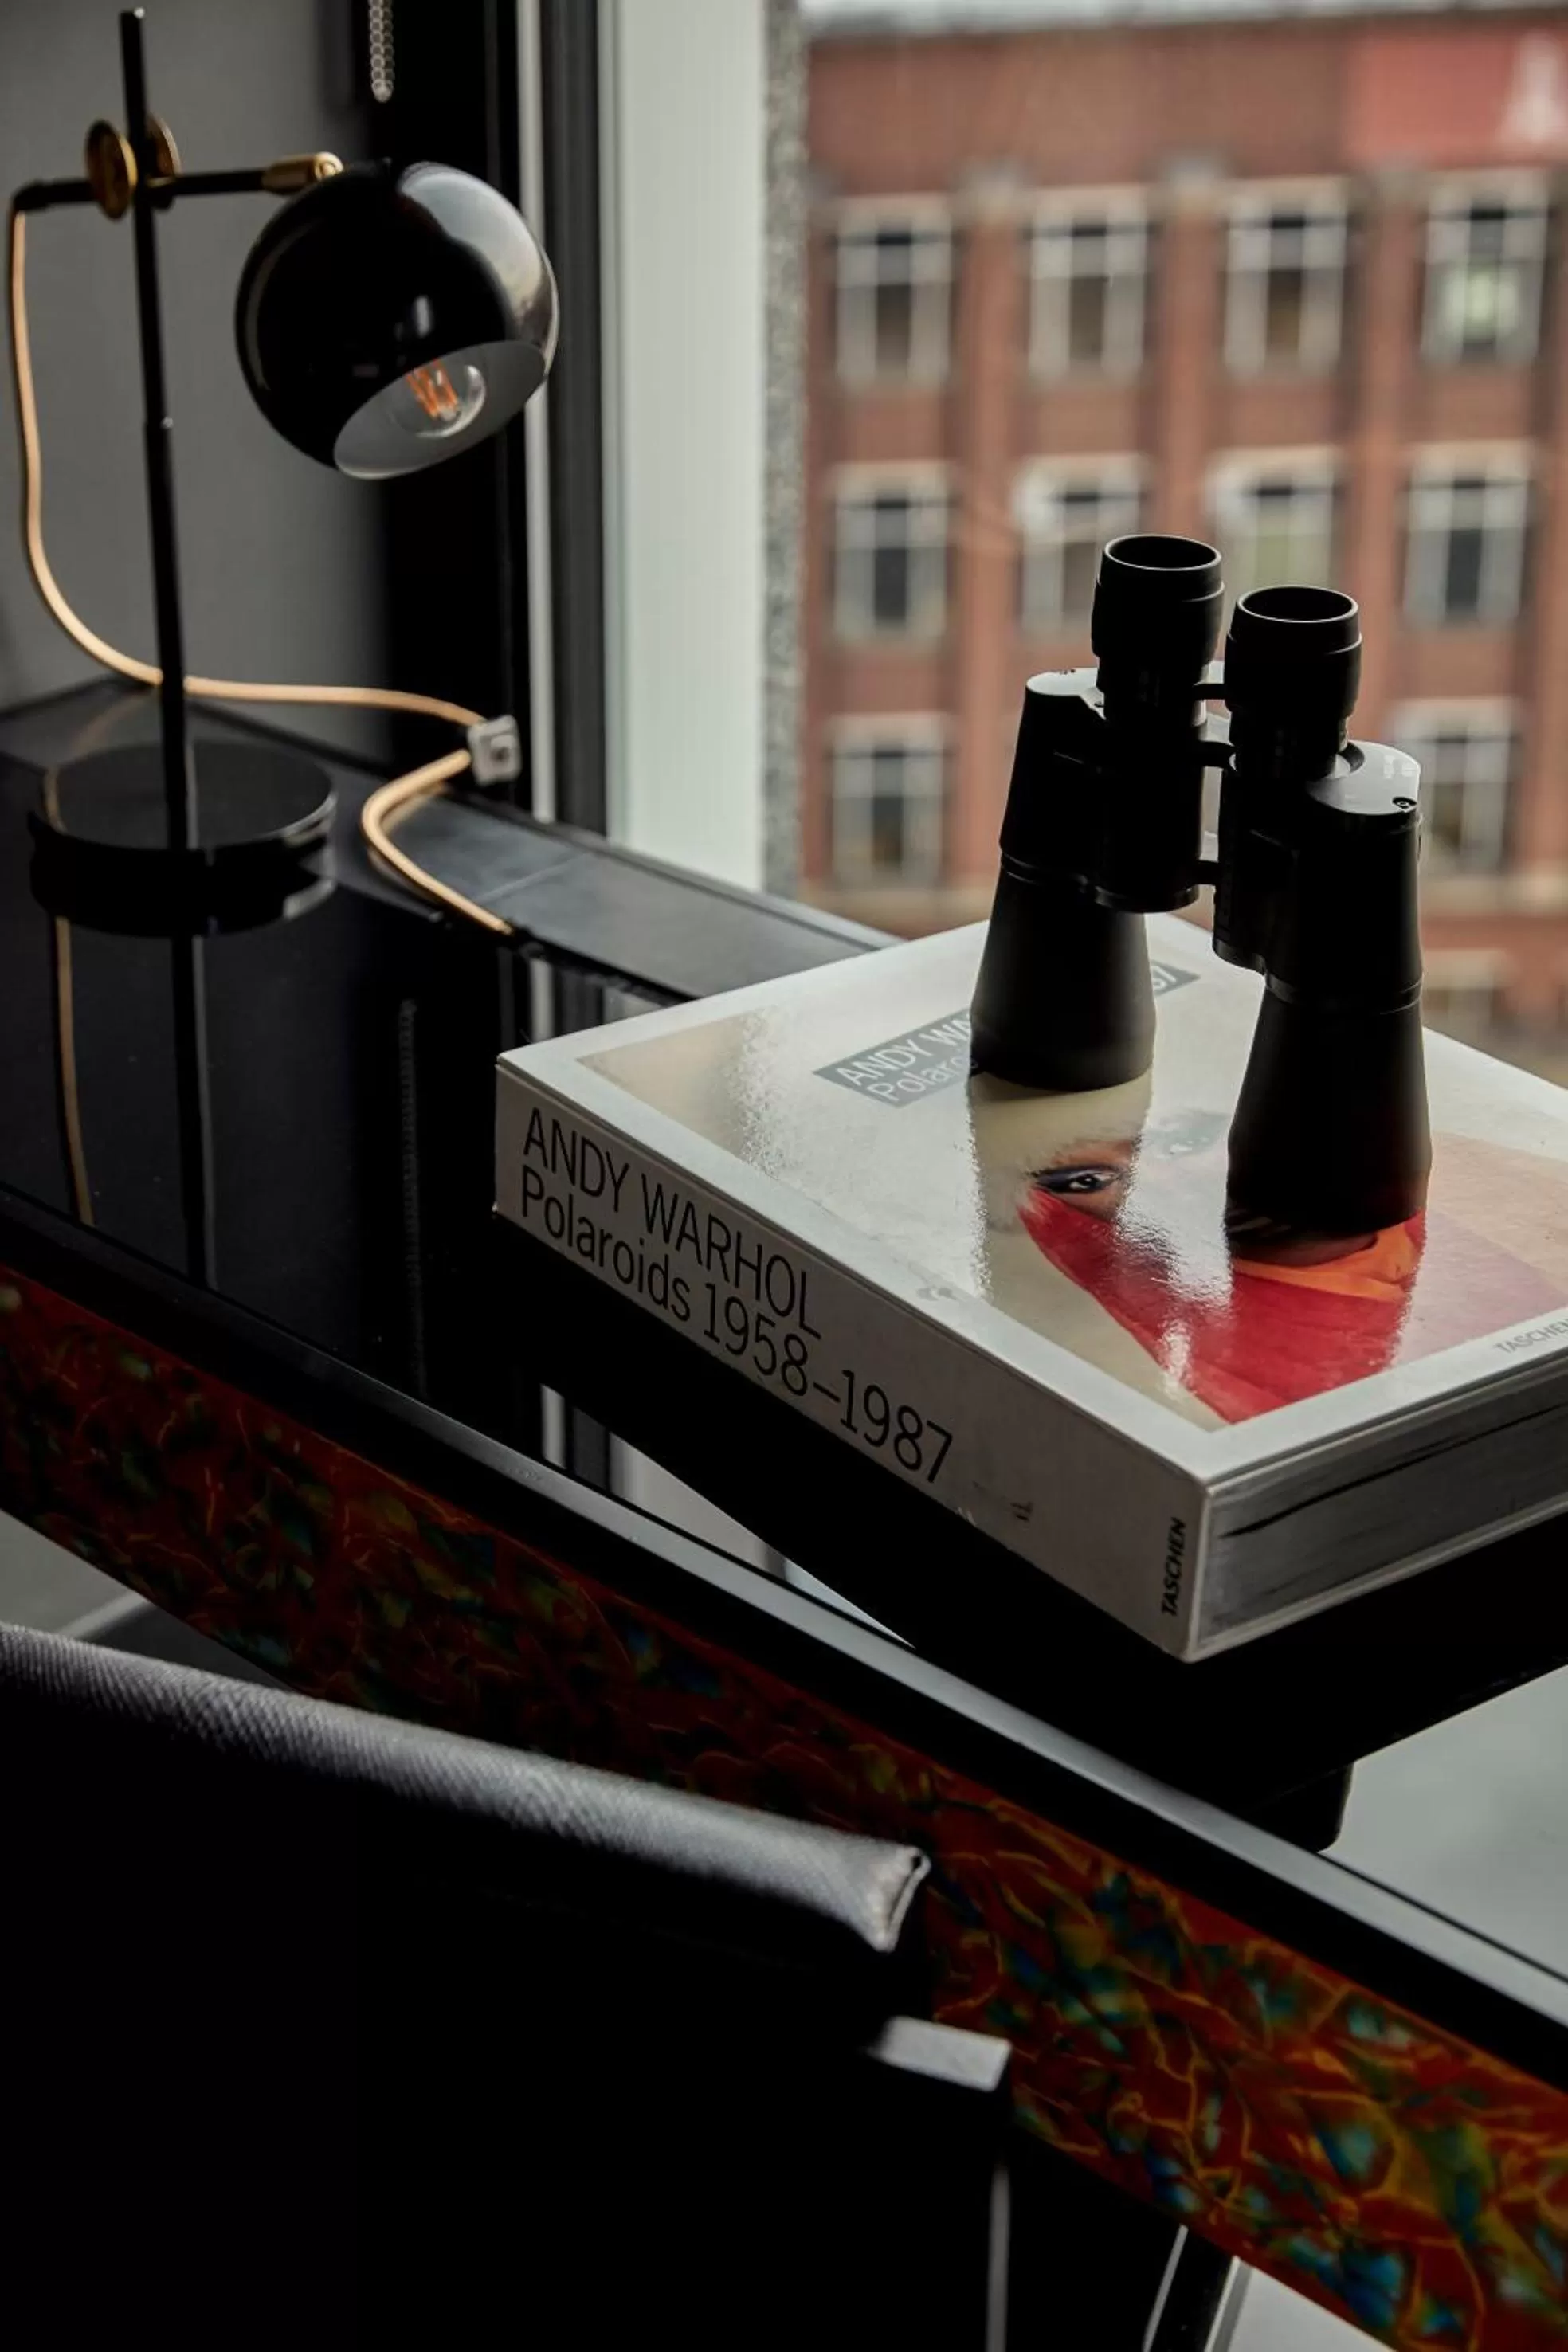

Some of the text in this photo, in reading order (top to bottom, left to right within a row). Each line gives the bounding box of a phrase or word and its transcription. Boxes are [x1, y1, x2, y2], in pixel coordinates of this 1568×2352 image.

[835, 1038, 933, 1087] ANDY
[521, 1164, 691, 1323] Polaroids
[523, 1107, 822, 1340] ANDY WARHOL
[1161, 1516, 1186, 1617] TASCHEN
